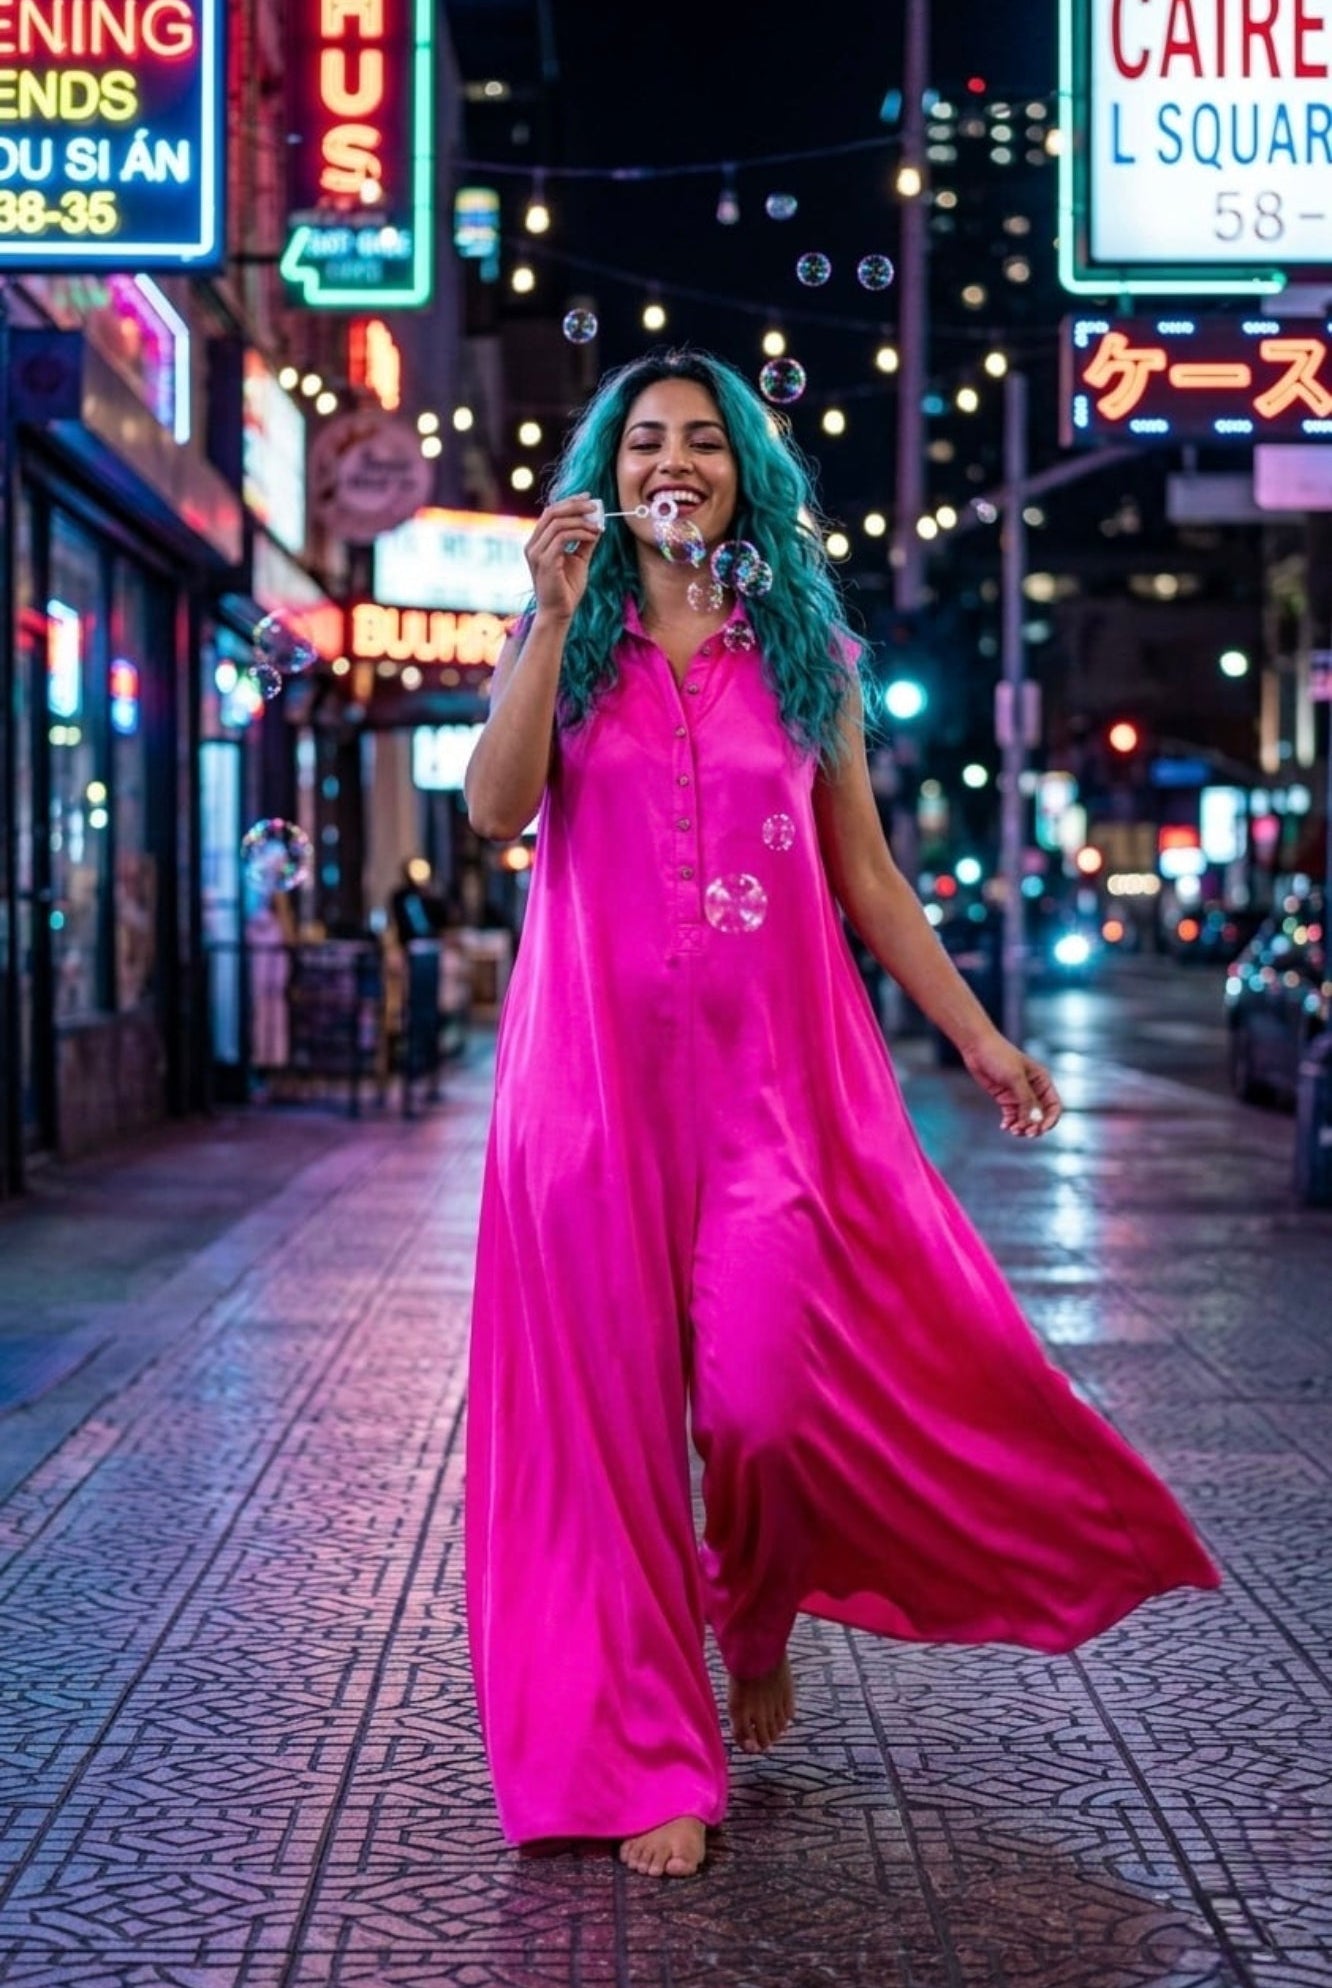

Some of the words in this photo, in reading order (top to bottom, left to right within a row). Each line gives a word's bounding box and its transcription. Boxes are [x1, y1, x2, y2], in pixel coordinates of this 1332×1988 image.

[0, 69, 138, 120] ENDS
[65, 137, 110, 182] SI
[119, 127, 190, 183] ÁN
[1113, 102, 1135, 164] L
[1157, 102, 1332, 170] SQUAR
[1082, 331, 1332, 419] ケース
